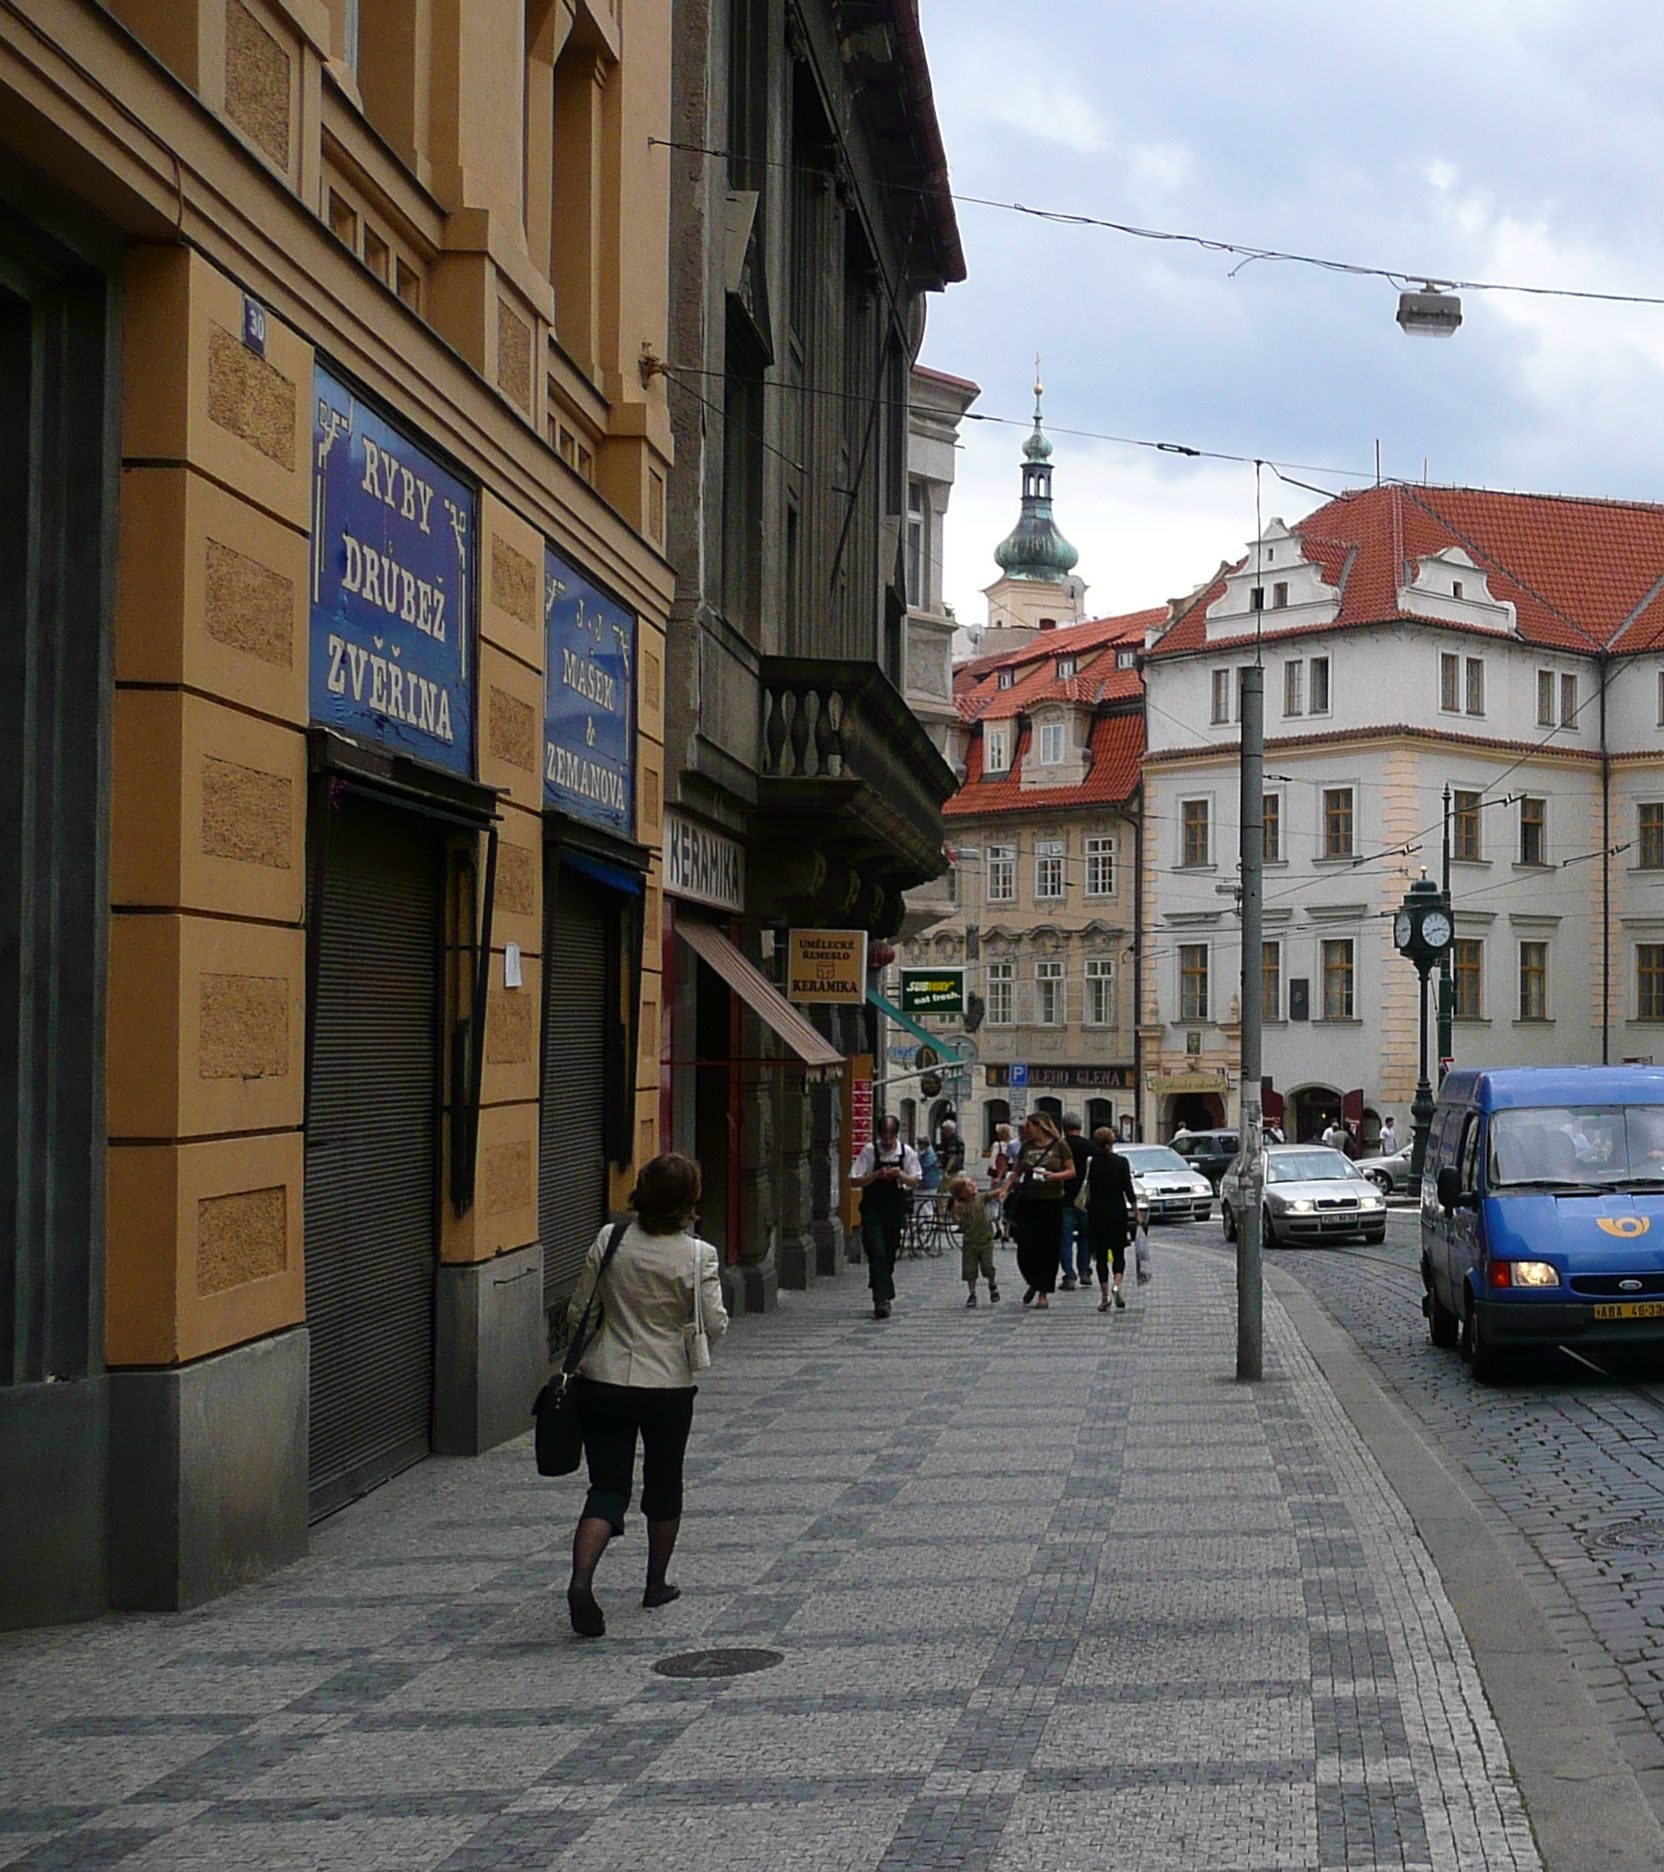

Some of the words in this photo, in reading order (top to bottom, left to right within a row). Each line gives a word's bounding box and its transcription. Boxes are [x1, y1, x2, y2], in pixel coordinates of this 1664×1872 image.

[250, 309, 265, 340] 30
[361, 435, 434, 536] RYBY
[341, 531, 446, 643] DRŮBEŽ
[327, 633, 454, 741] ZVĚŘINA
[562, 646, 614, 712] MAŠEK
[585, 715, 596, 748] &
[547, 741, 626, 811] ZEMANOVÁ
[670, 818, 739, 904] KERAMIKA
[799, 939, 856, 950] UMĚLECKÉ
[792, 979, 858, 993] KERAMIKA
[906, 981, 955, 992] SUBWAY
[914, 996, 931, 1005] eat
[1013, 1066, 1024, 1080] P
[1601, 1306, 1622, 1317] ABA
